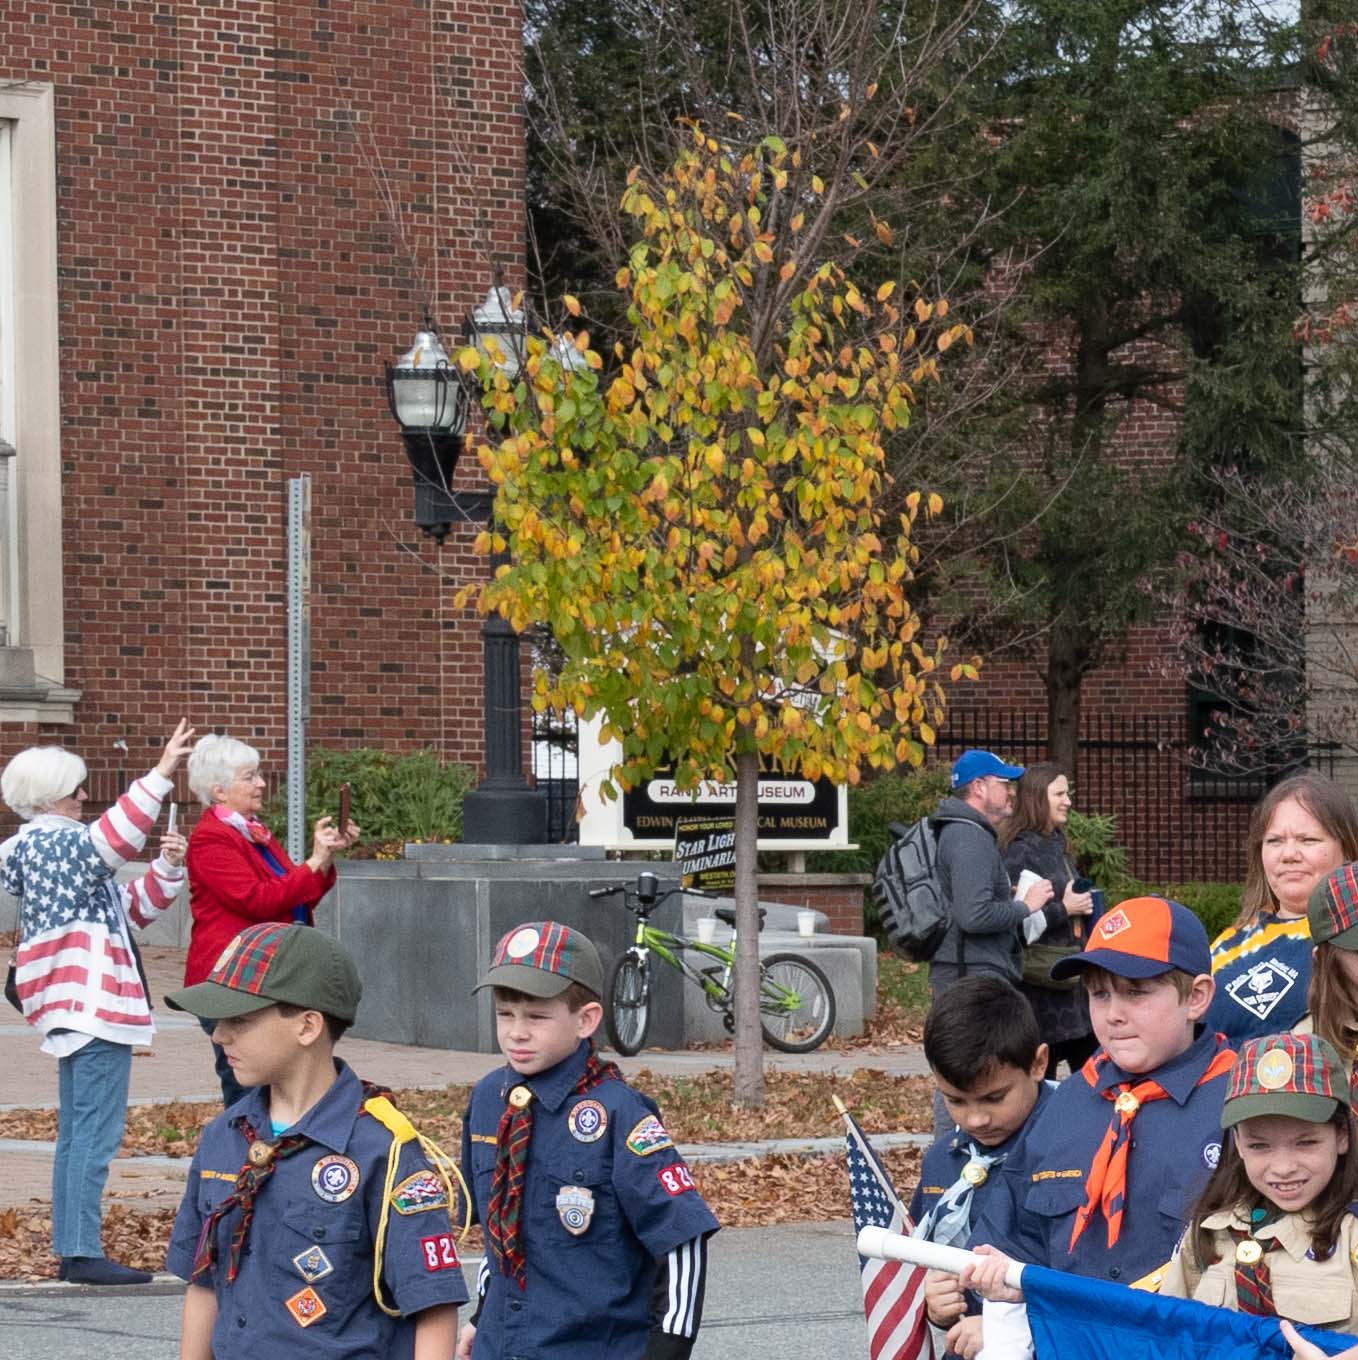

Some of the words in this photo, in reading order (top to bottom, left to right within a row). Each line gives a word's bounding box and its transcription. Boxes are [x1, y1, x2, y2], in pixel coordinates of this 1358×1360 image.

[708, 786, 737, 797] ART
[756, 786, 805, 798] USEUM
[636, 816, 673, 828] EDWIN
[780, 816, 828, 828] MUSEUM
[676, 840, 706, 859] STAR
[707, 832, 737, 851] LIGH
[680, 851, 737, 875] UMINARIA
